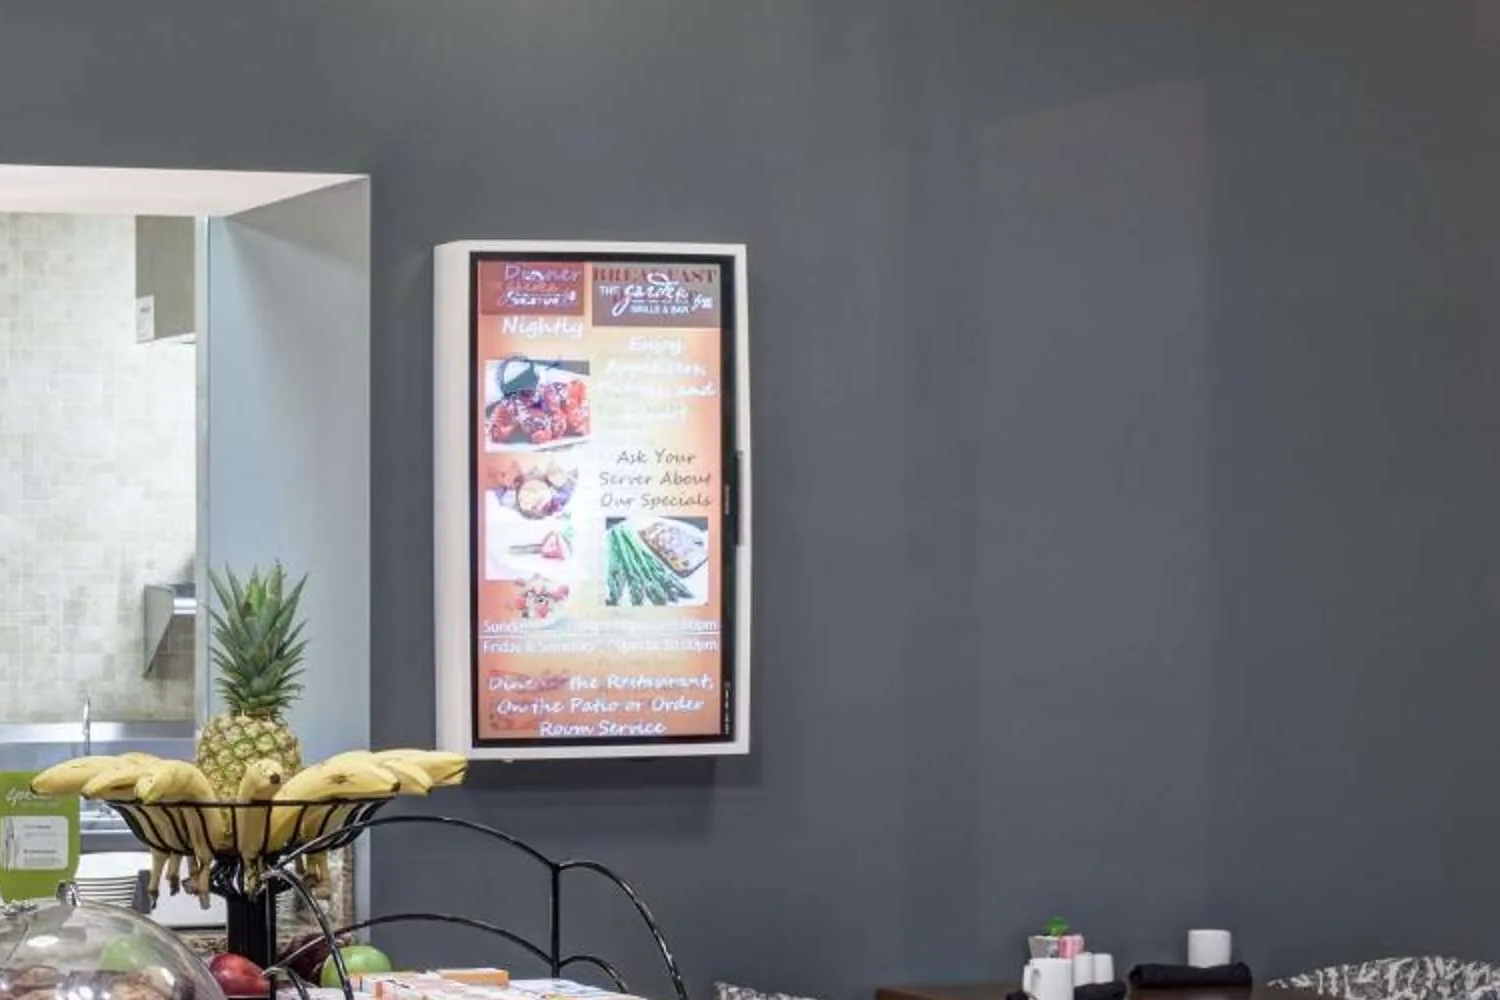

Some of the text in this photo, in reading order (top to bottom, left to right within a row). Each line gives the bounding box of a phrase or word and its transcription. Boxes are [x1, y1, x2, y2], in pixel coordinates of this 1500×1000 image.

[502, 315, 584, 340] Nightly
[617, 448, 697, 464] Ask Your
[599, 470, 712, 486] Server About
[600, 492, 636, 508] Our
[641, 492, 711, 510] Specials
[570, 697, 620, 714] Patio
[650, 696, 706, 713] Order
[599, 719, 668, 736] Service
